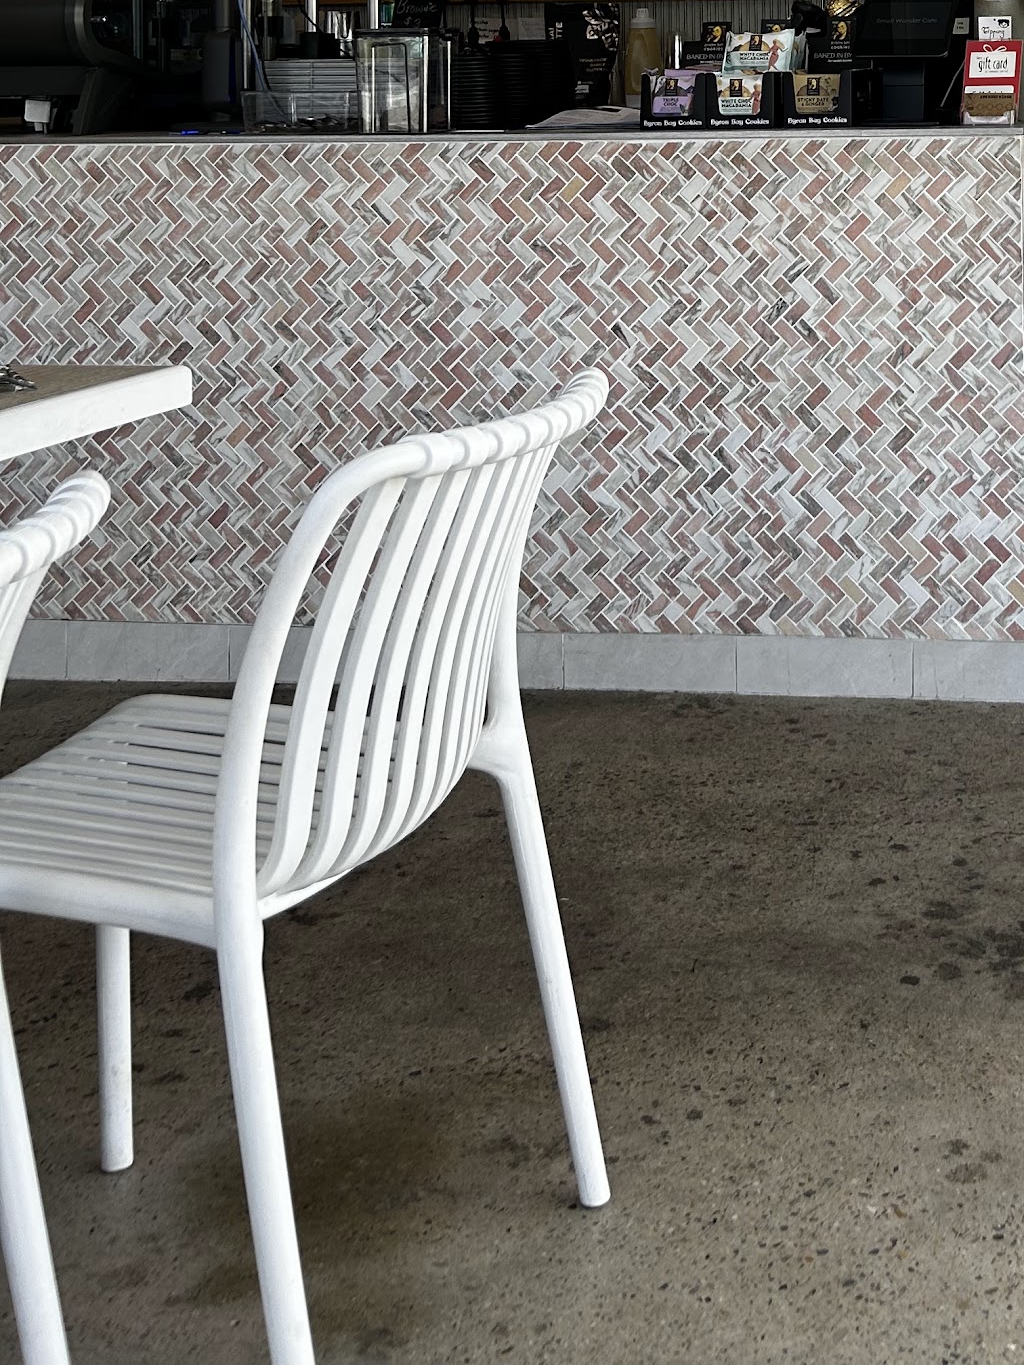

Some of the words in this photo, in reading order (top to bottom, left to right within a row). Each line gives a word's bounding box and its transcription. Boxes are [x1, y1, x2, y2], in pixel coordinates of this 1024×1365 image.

[978, 56, 991, 73] gift
[993, 56, 1008, 70] card
[643, 119, 663, 127] Byron
[663, 119, 677, 127] Bay
[678, 118, 703, 126] Cookies
[787, 117, 807, 125] Byron
[808, 117, 821, 125] Bay
[822, 116, 848, 124] Cookies
